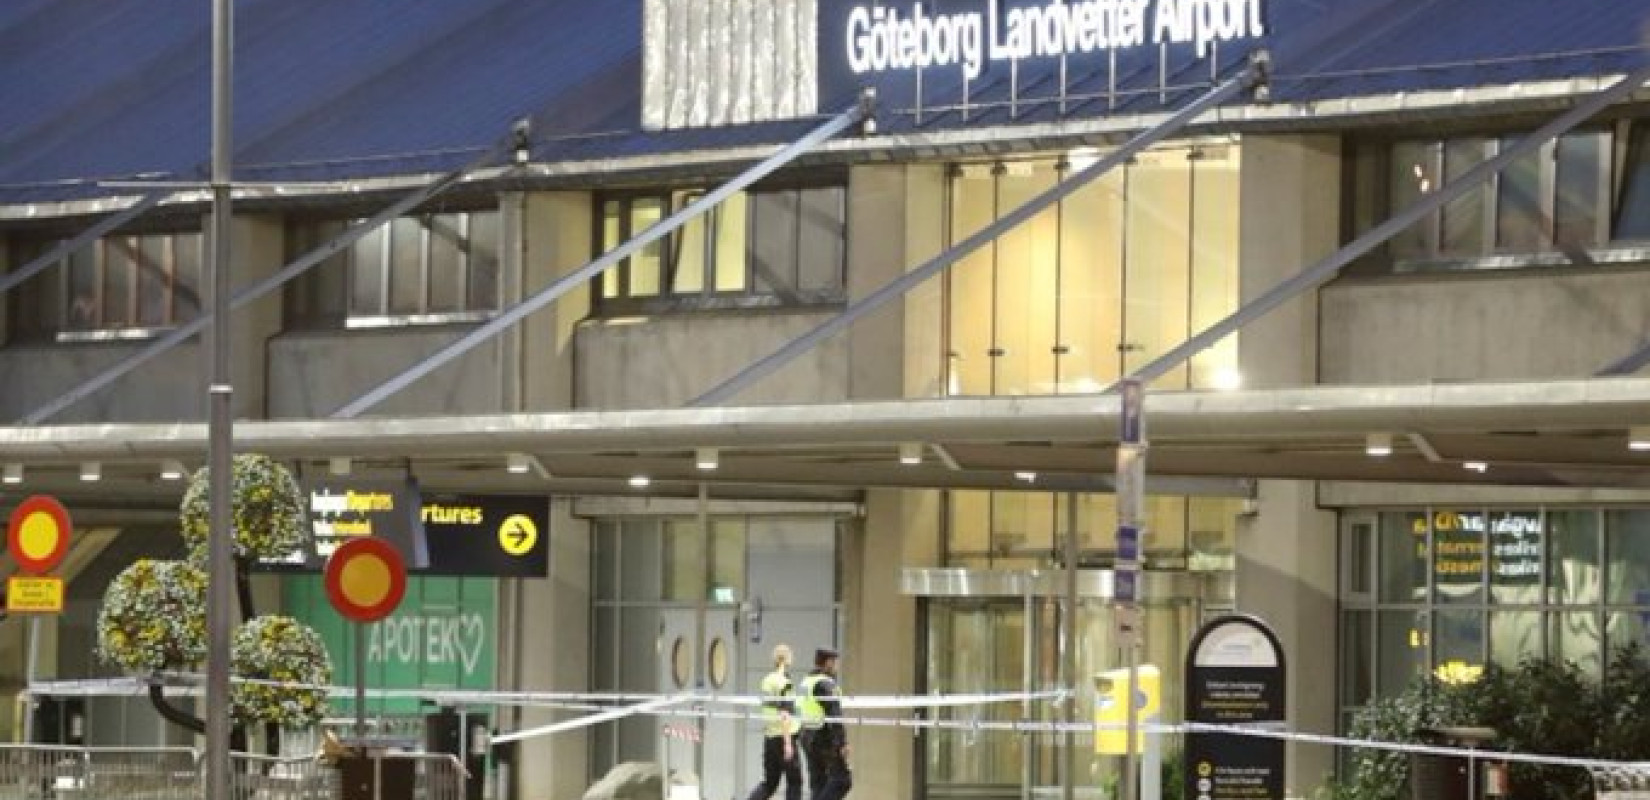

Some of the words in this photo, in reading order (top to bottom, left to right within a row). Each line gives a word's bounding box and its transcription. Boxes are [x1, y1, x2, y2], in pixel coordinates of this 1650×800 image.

[847, 2, 982, 80] Göteborg
[989, 0, 1148, 60] Landvetter
[1151, 0, 1263, 59] Airport
[421, 503, 483, 525] rtures
[368, 616, 456, 663] APOTEK
